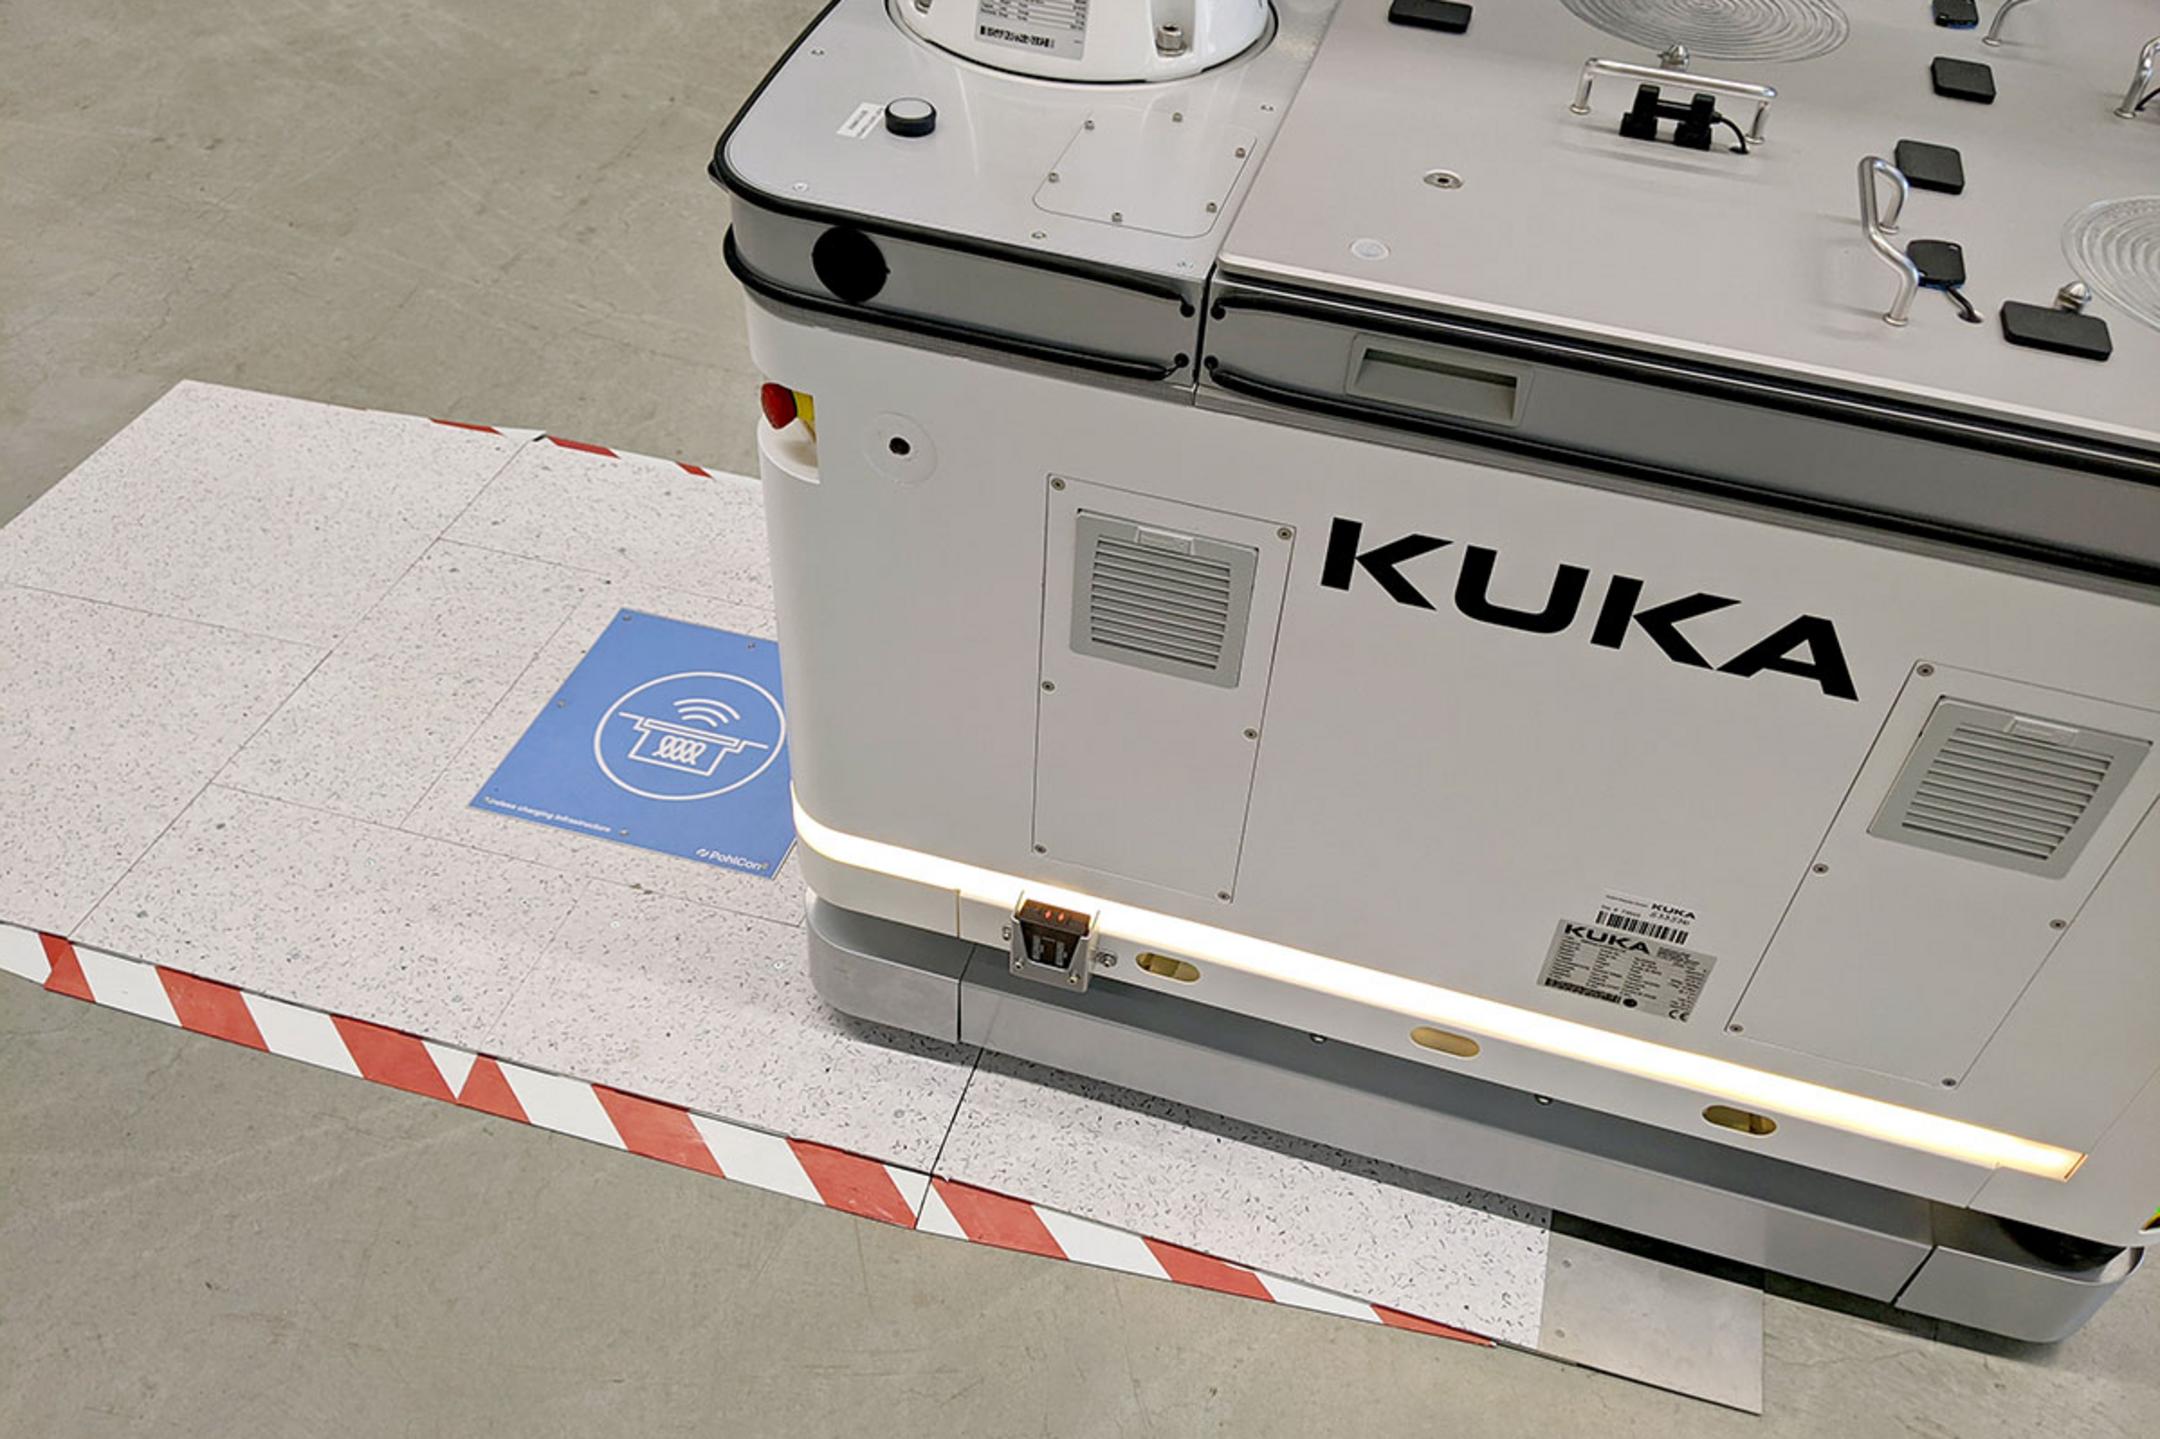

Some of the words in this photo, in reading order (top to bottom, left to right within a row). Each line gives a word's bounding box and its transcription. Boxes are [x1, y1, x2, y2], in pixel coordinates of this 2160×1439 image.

[1320, 517, 1860, 702] KUKA
[708, 849, 763, 871] PohlCon
[1651, 903, 1696, 920] KUKA
[1564, 923, 1650, 955] KUKA
